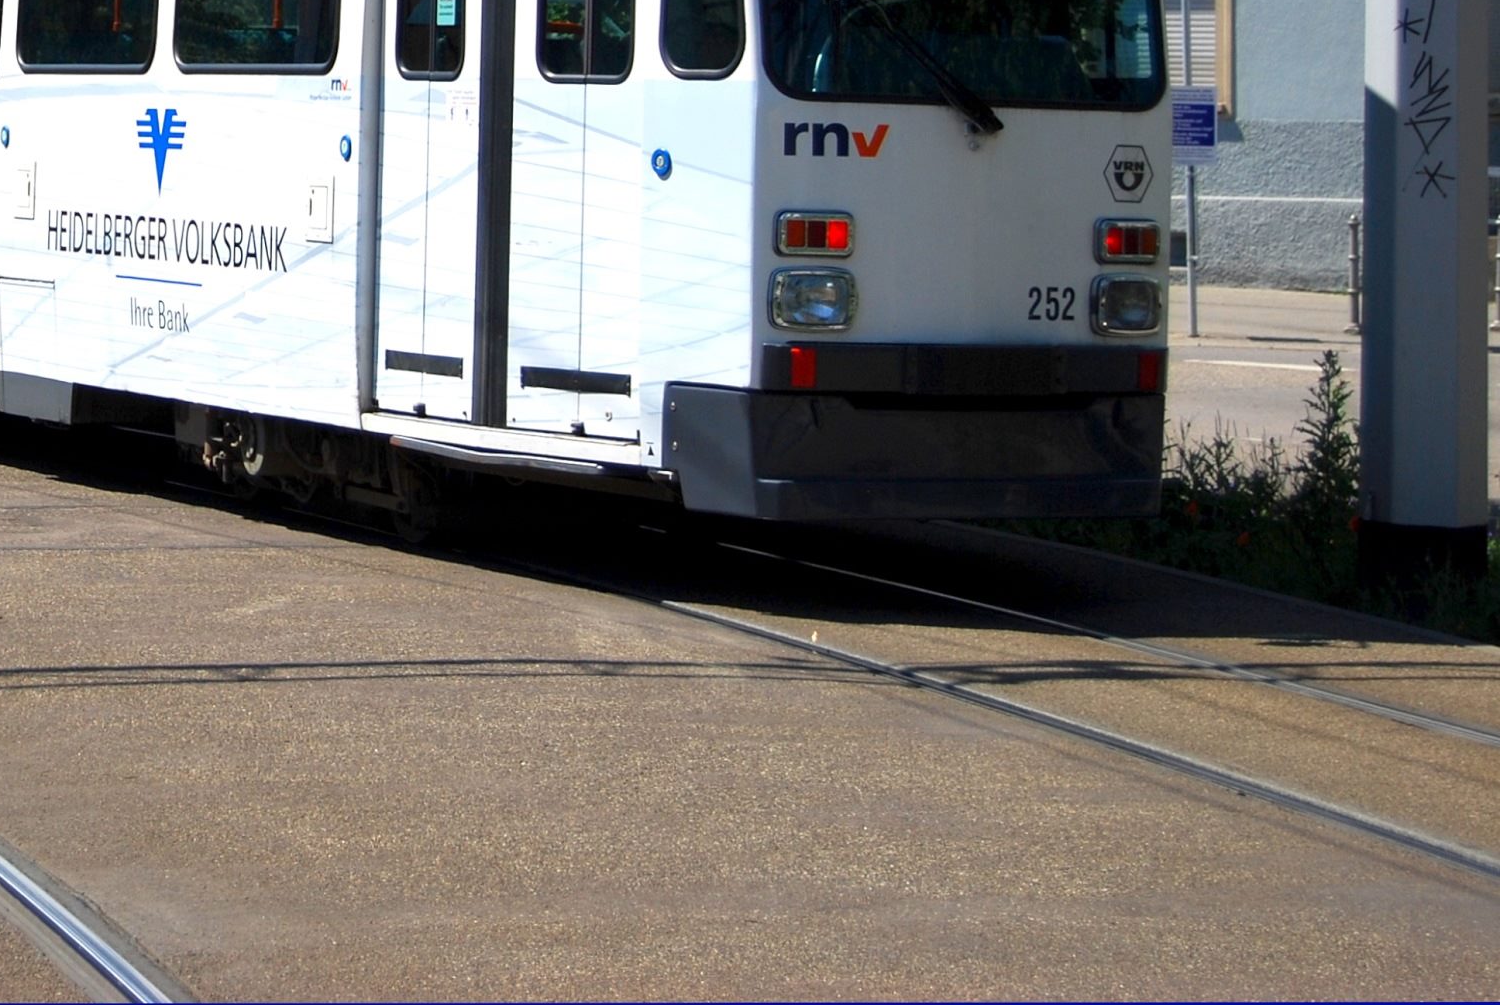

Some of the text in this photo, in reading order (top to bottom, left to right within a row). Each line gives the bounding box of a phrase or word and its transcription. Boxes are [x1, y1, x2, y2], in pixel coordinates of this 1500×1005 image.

[784, 122, 889, 158] rnv
[1114, 161, 1145, 172] VRN
[47, 209, 288, 273] HEIDELBERGER VOLKSBANK
[130, 297, 190, 333] Ihre Bank
[1028, 287, 1076, 322] 252
